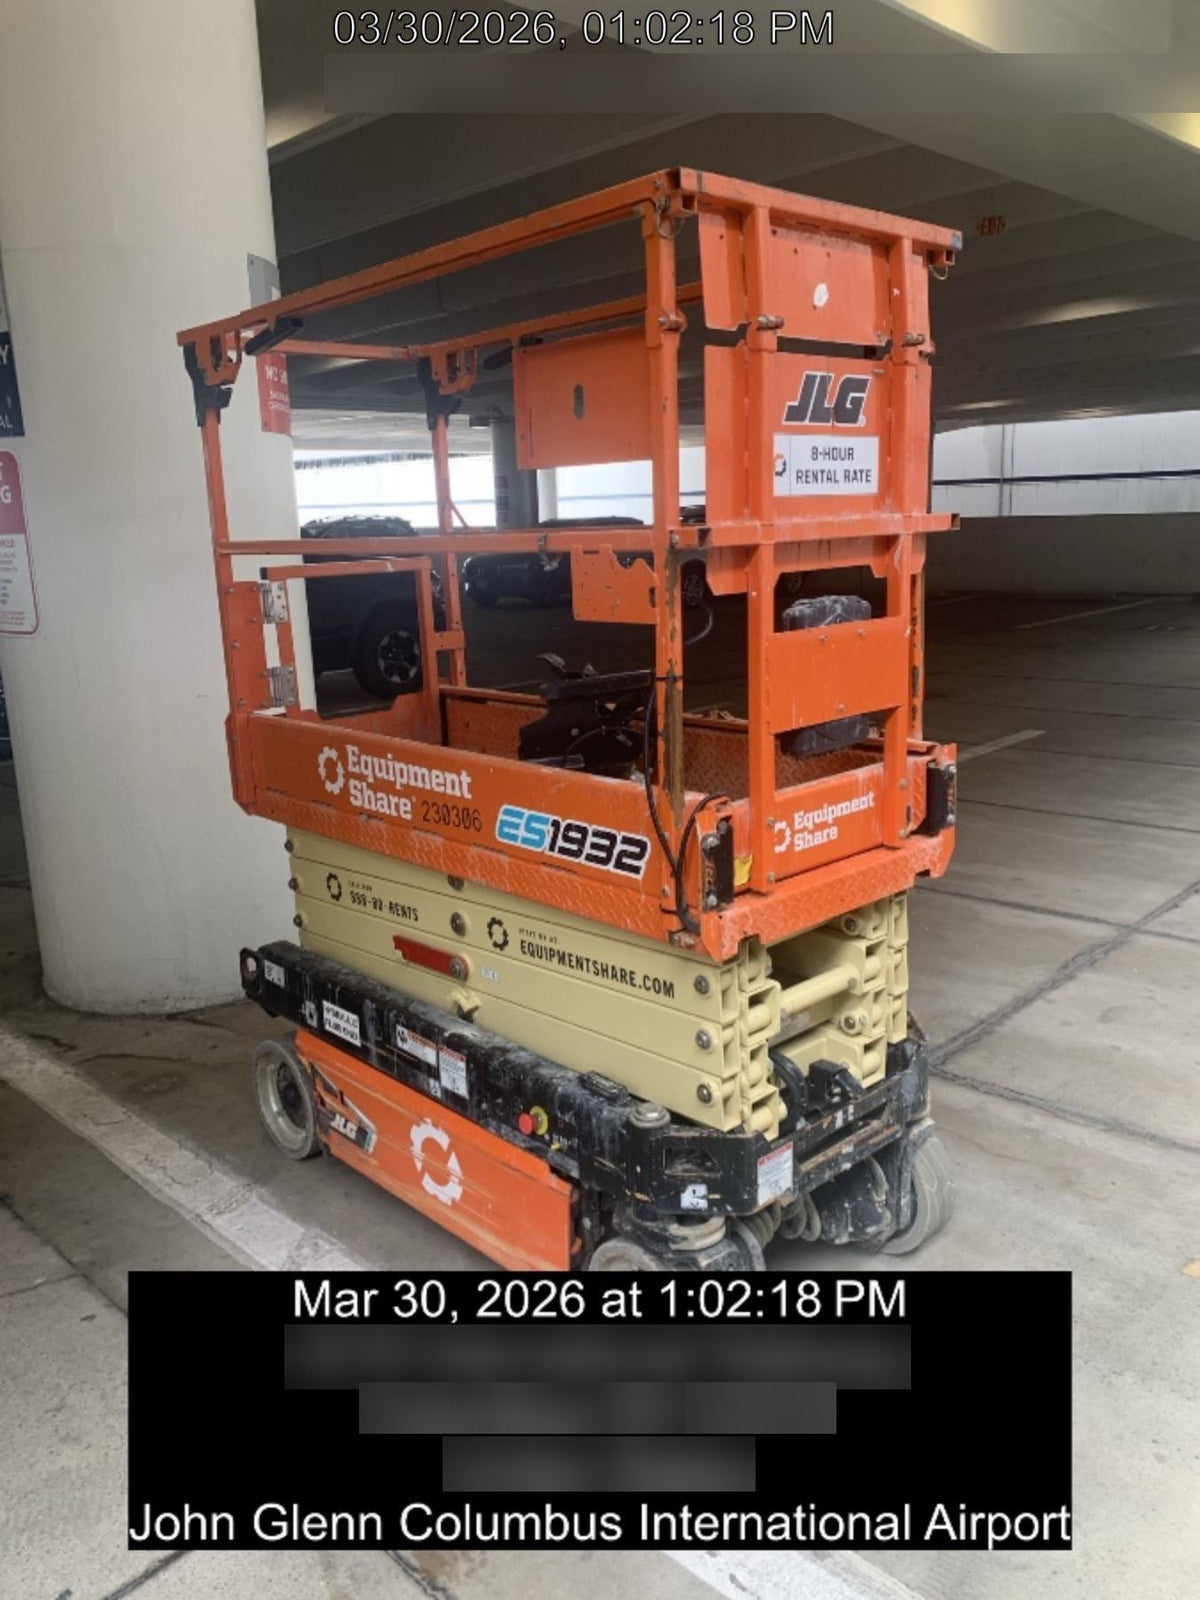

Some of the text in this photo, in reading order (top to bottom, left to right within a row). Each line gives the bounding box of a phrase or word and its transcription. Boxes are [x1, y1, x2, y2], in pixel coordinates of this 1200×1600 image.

[782, 371, 872, 427] JLG
[811, 446, 854, 461] 8-HOUR
[795, 468, 872, 484] RENTAL RATE
[346, 744, 472, 799] Equipment
[349, 779, 412, 820] Share
[420, 800, 483, 832] 230306
[794, 791, 875, 830] Equipment
[496, 804, 651, 880] ES1932
[794, 826, 838, 852] Share
[520, 939, 676, 1000] EQUIPMENTSHARE.COM
